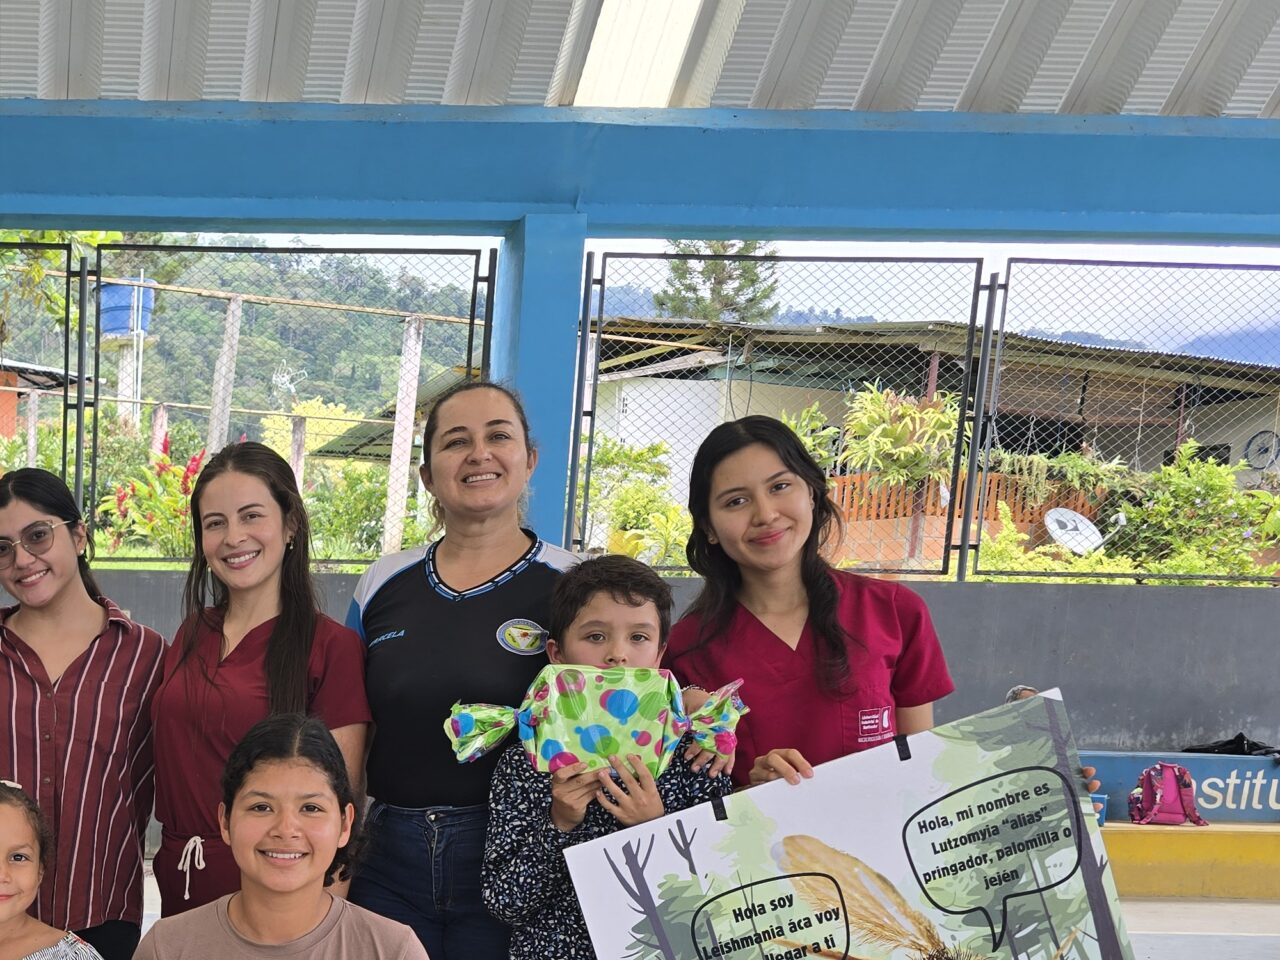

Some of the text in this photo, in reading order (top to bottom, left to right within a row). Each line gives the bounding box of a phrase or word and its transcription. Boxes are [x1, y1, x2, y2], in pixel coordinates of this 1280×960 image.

[917, 782, 1050, 834] Hola, mi nombre es
[931, 824, 1000, 855] Lutzomyia
[922, 827, 1072, 884] pringador, palomilla o
[984, 869, 1019, 890] jején
[732, 893, 793, 923] Hola soy
[702, 906, 840, 960] Leishmania áca voy
[812, 941, 821, 953] a
[824, 934, 836, 949] ti
